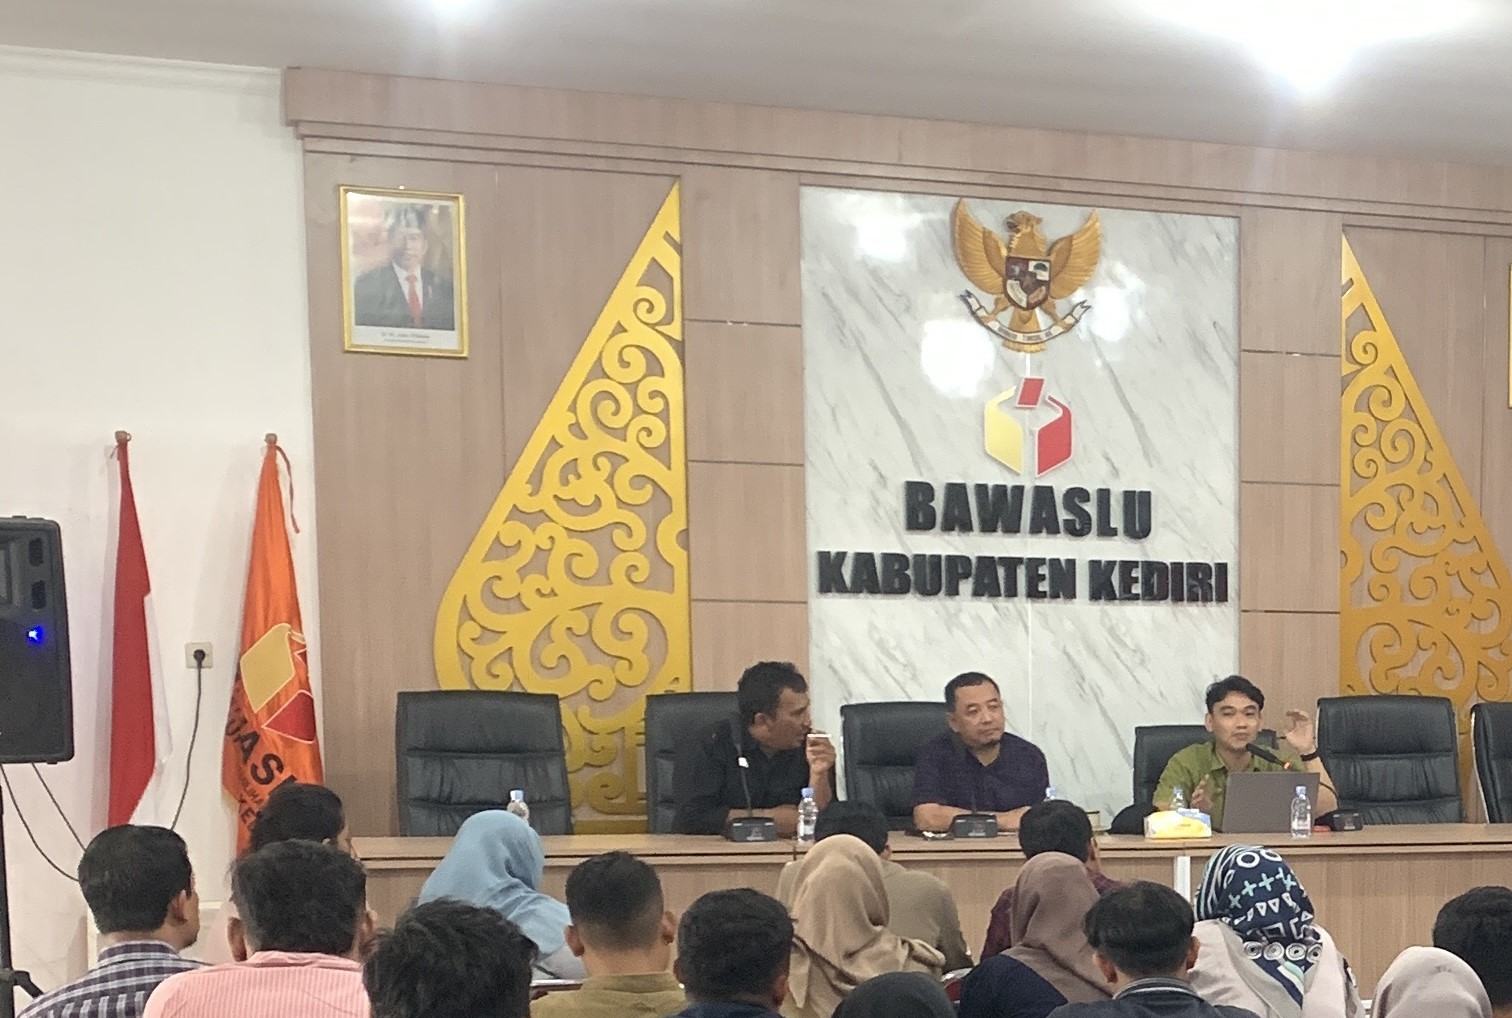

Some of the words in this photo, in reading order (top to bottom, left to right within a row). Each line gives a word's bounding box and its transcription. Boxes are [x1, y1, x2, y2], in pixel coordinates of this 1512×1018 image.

[904, 480, 1152, 540] BAWASLU
[816, 550, 1077, 599] KABUPATEN
[1088, 559, 1229, 603] KEDIRI
